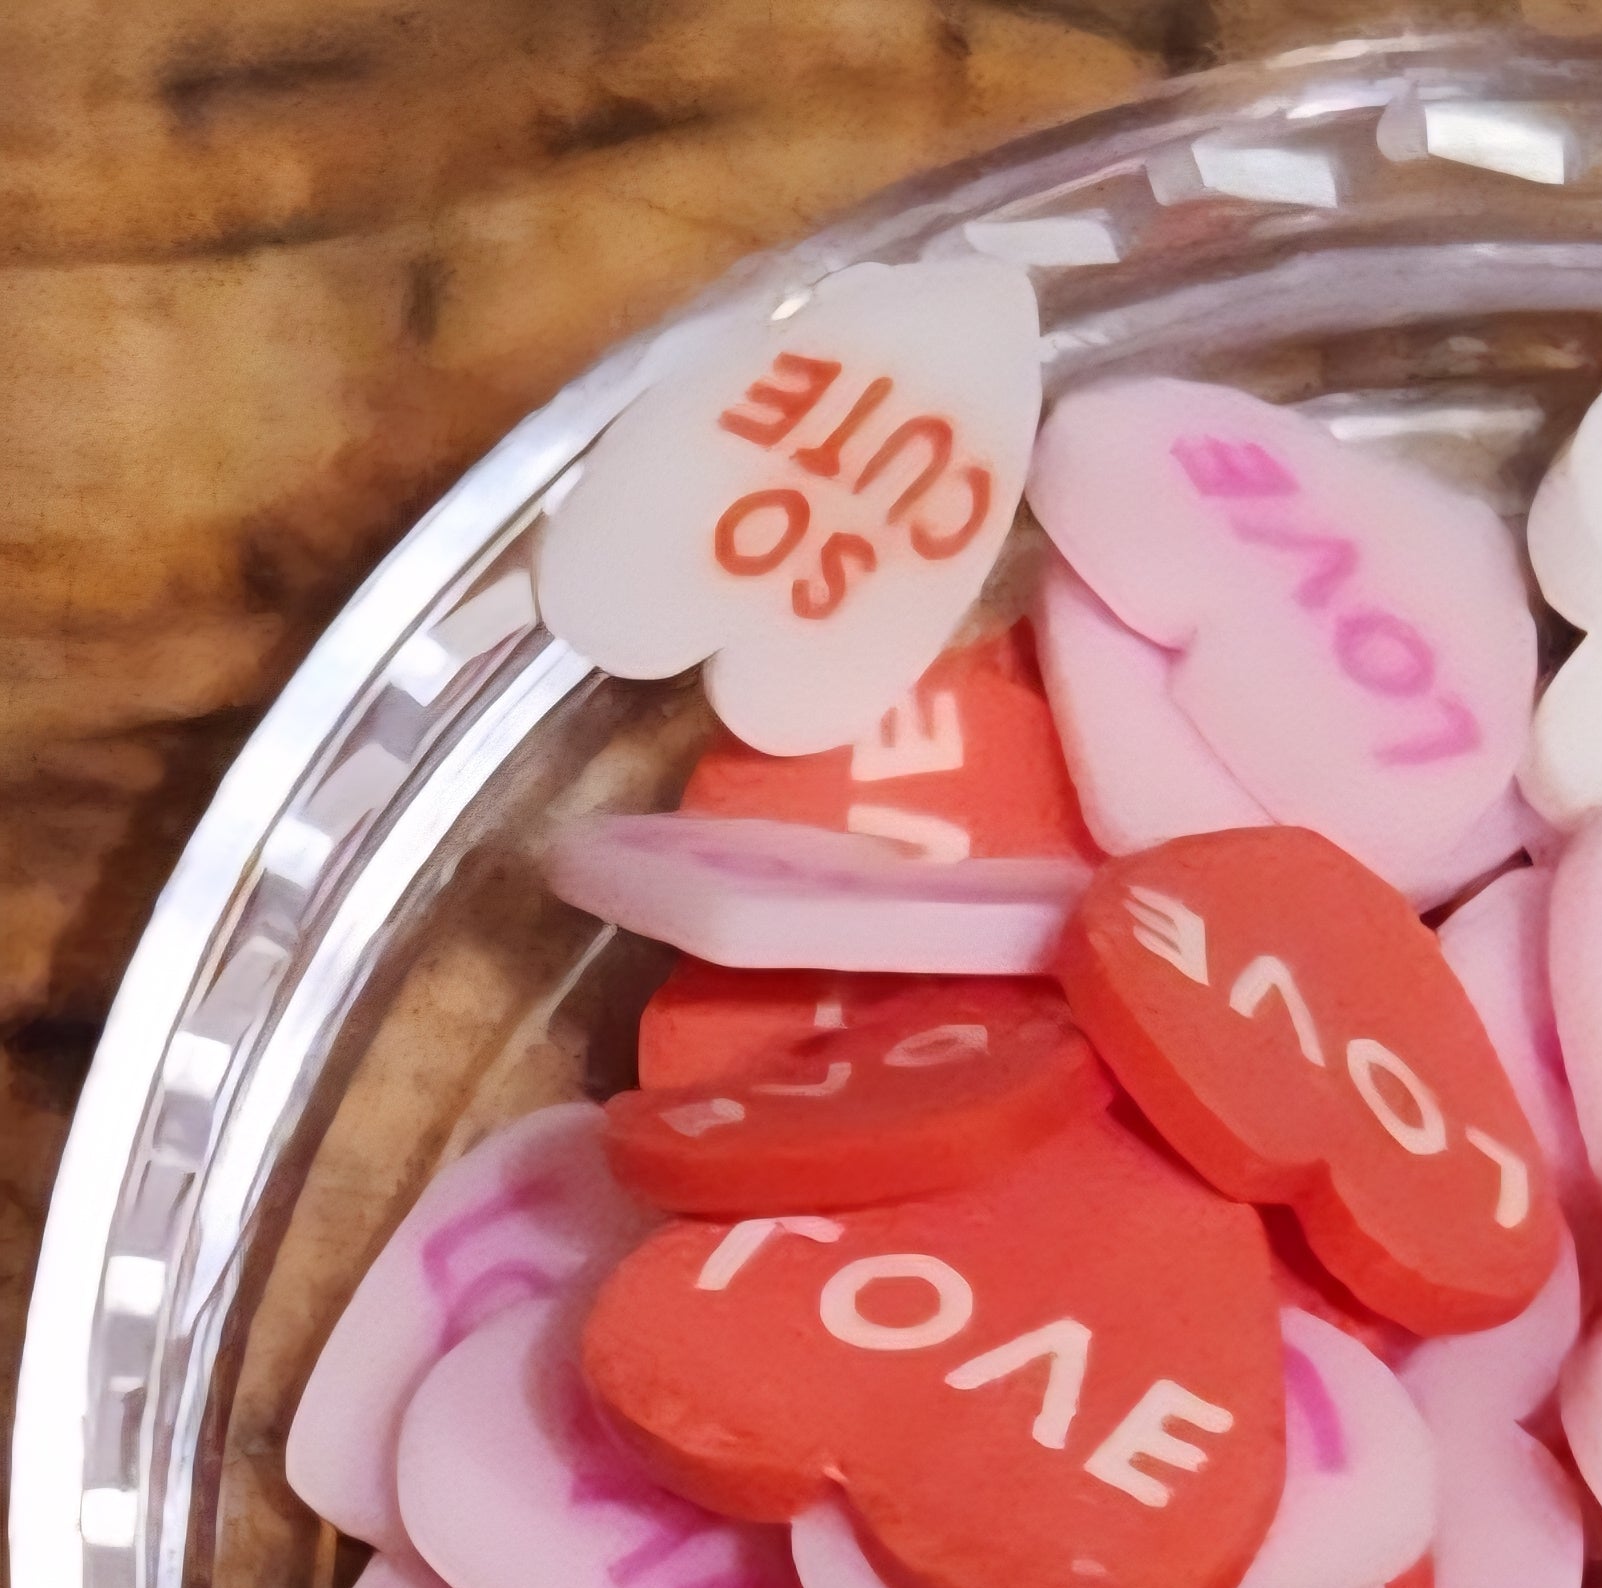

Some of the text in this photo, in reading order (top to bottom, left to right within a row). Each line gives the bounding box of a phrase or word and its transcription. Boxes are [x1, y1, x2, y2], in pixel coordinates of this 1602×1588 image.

[713, 488, 878, 620] SO
[716, 351, 992, 561] CUTE
[1168, 434, 1485, 768] LOVE
[1123, 884, 1530, 1229] LOVE
